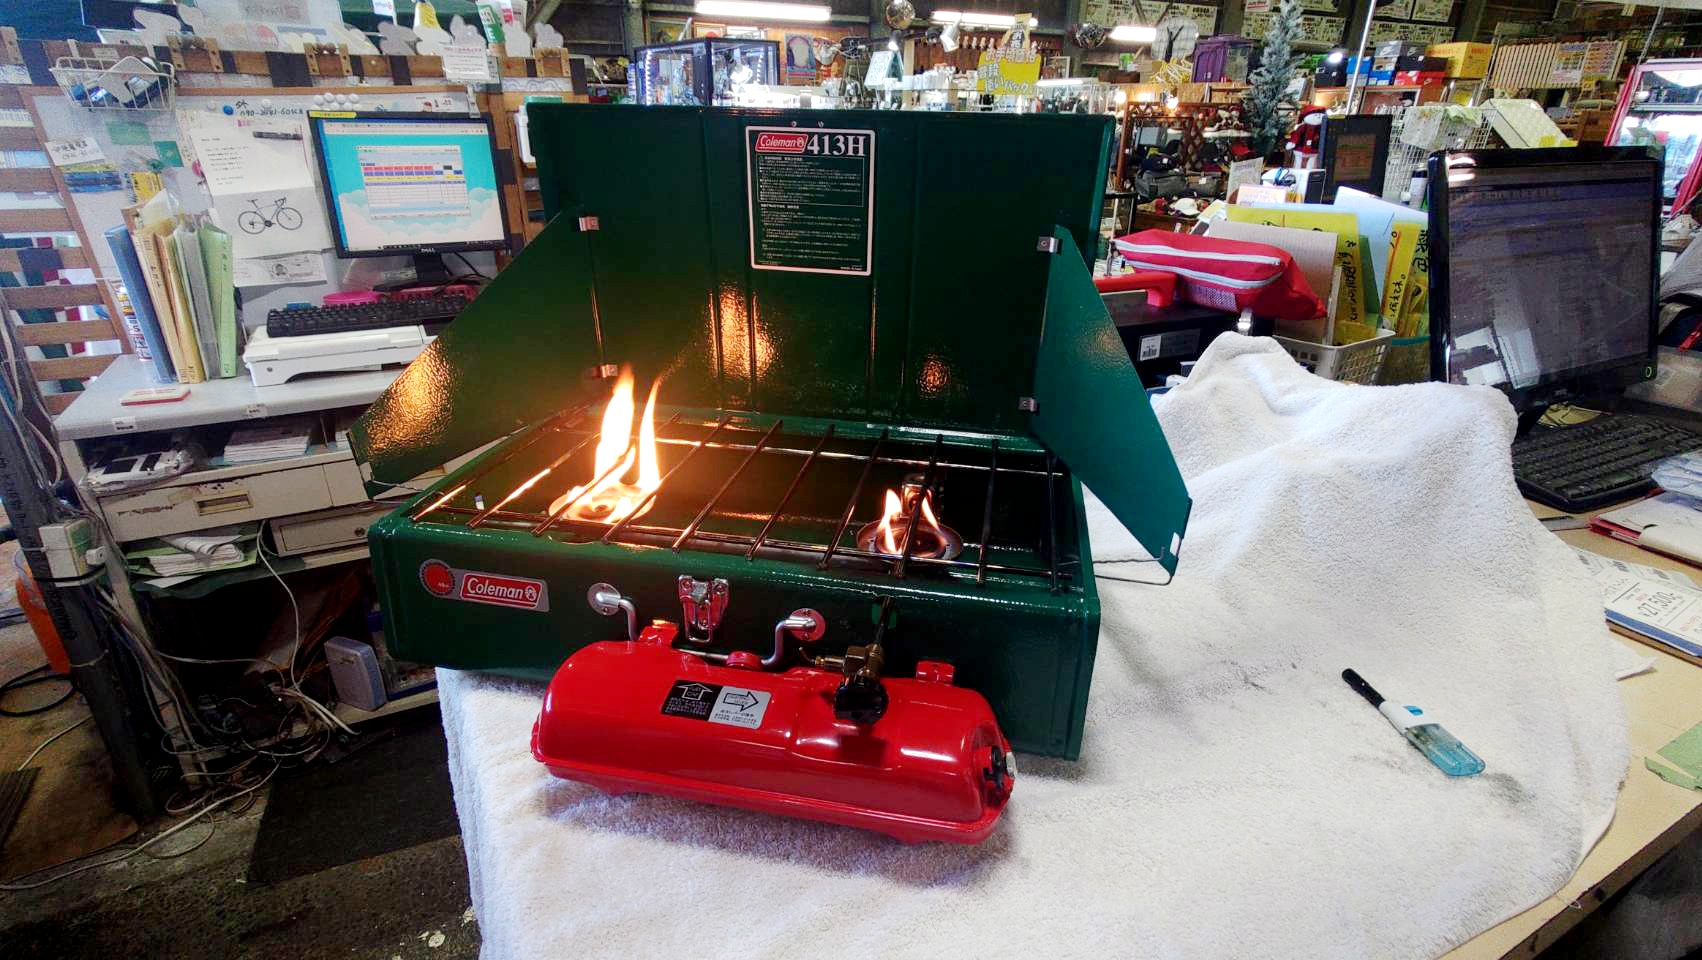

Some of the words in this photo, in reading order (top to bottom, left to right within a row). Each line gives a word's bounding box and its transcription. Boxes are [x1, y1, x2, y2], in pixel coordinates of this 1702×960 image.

[760, 135, 796, 147] Coleman
[807, 134, 865, 156] 413H
[467, 578, 524, 599] Coleman
